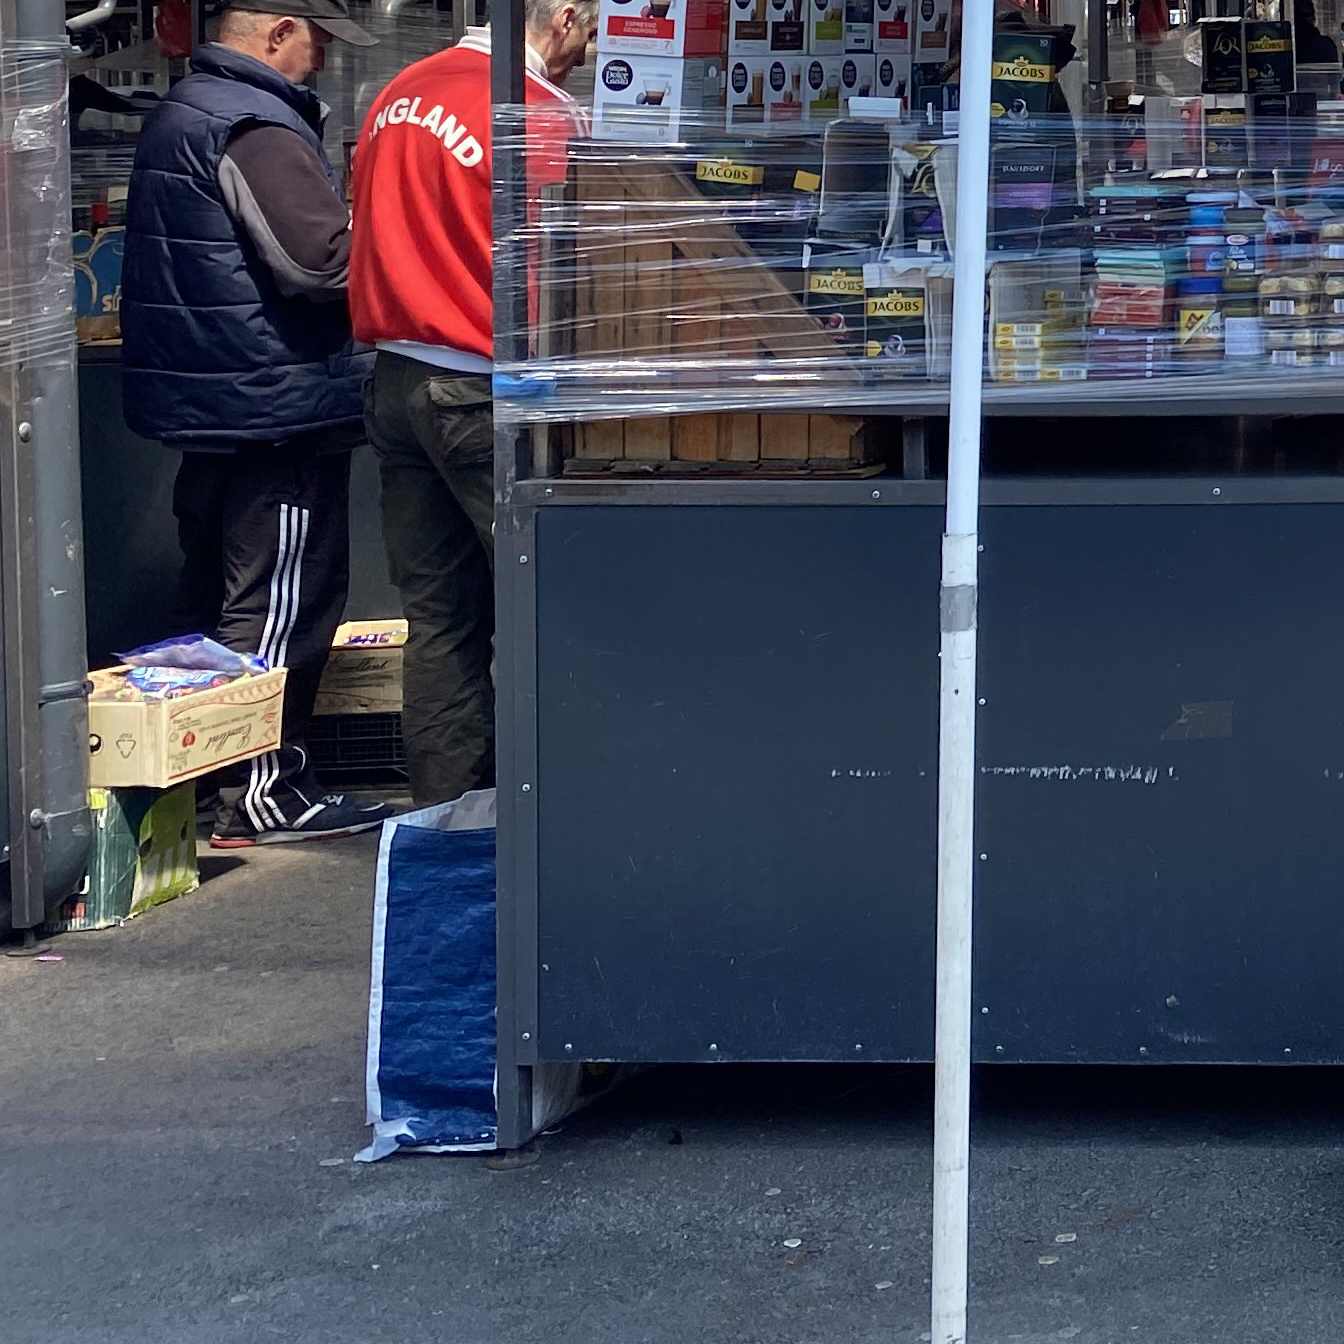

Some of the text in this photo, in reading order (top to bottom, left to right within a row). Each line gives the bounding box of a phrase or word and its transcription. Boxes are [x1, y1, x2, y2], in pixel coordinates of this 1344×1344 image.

[997, 66, 1045, 78] JACOBS
[700, 165, 748, 180] JACOBS
[815, 278, 863, 292] JACOBS
[871, 300, 920, 313] JACOBS
